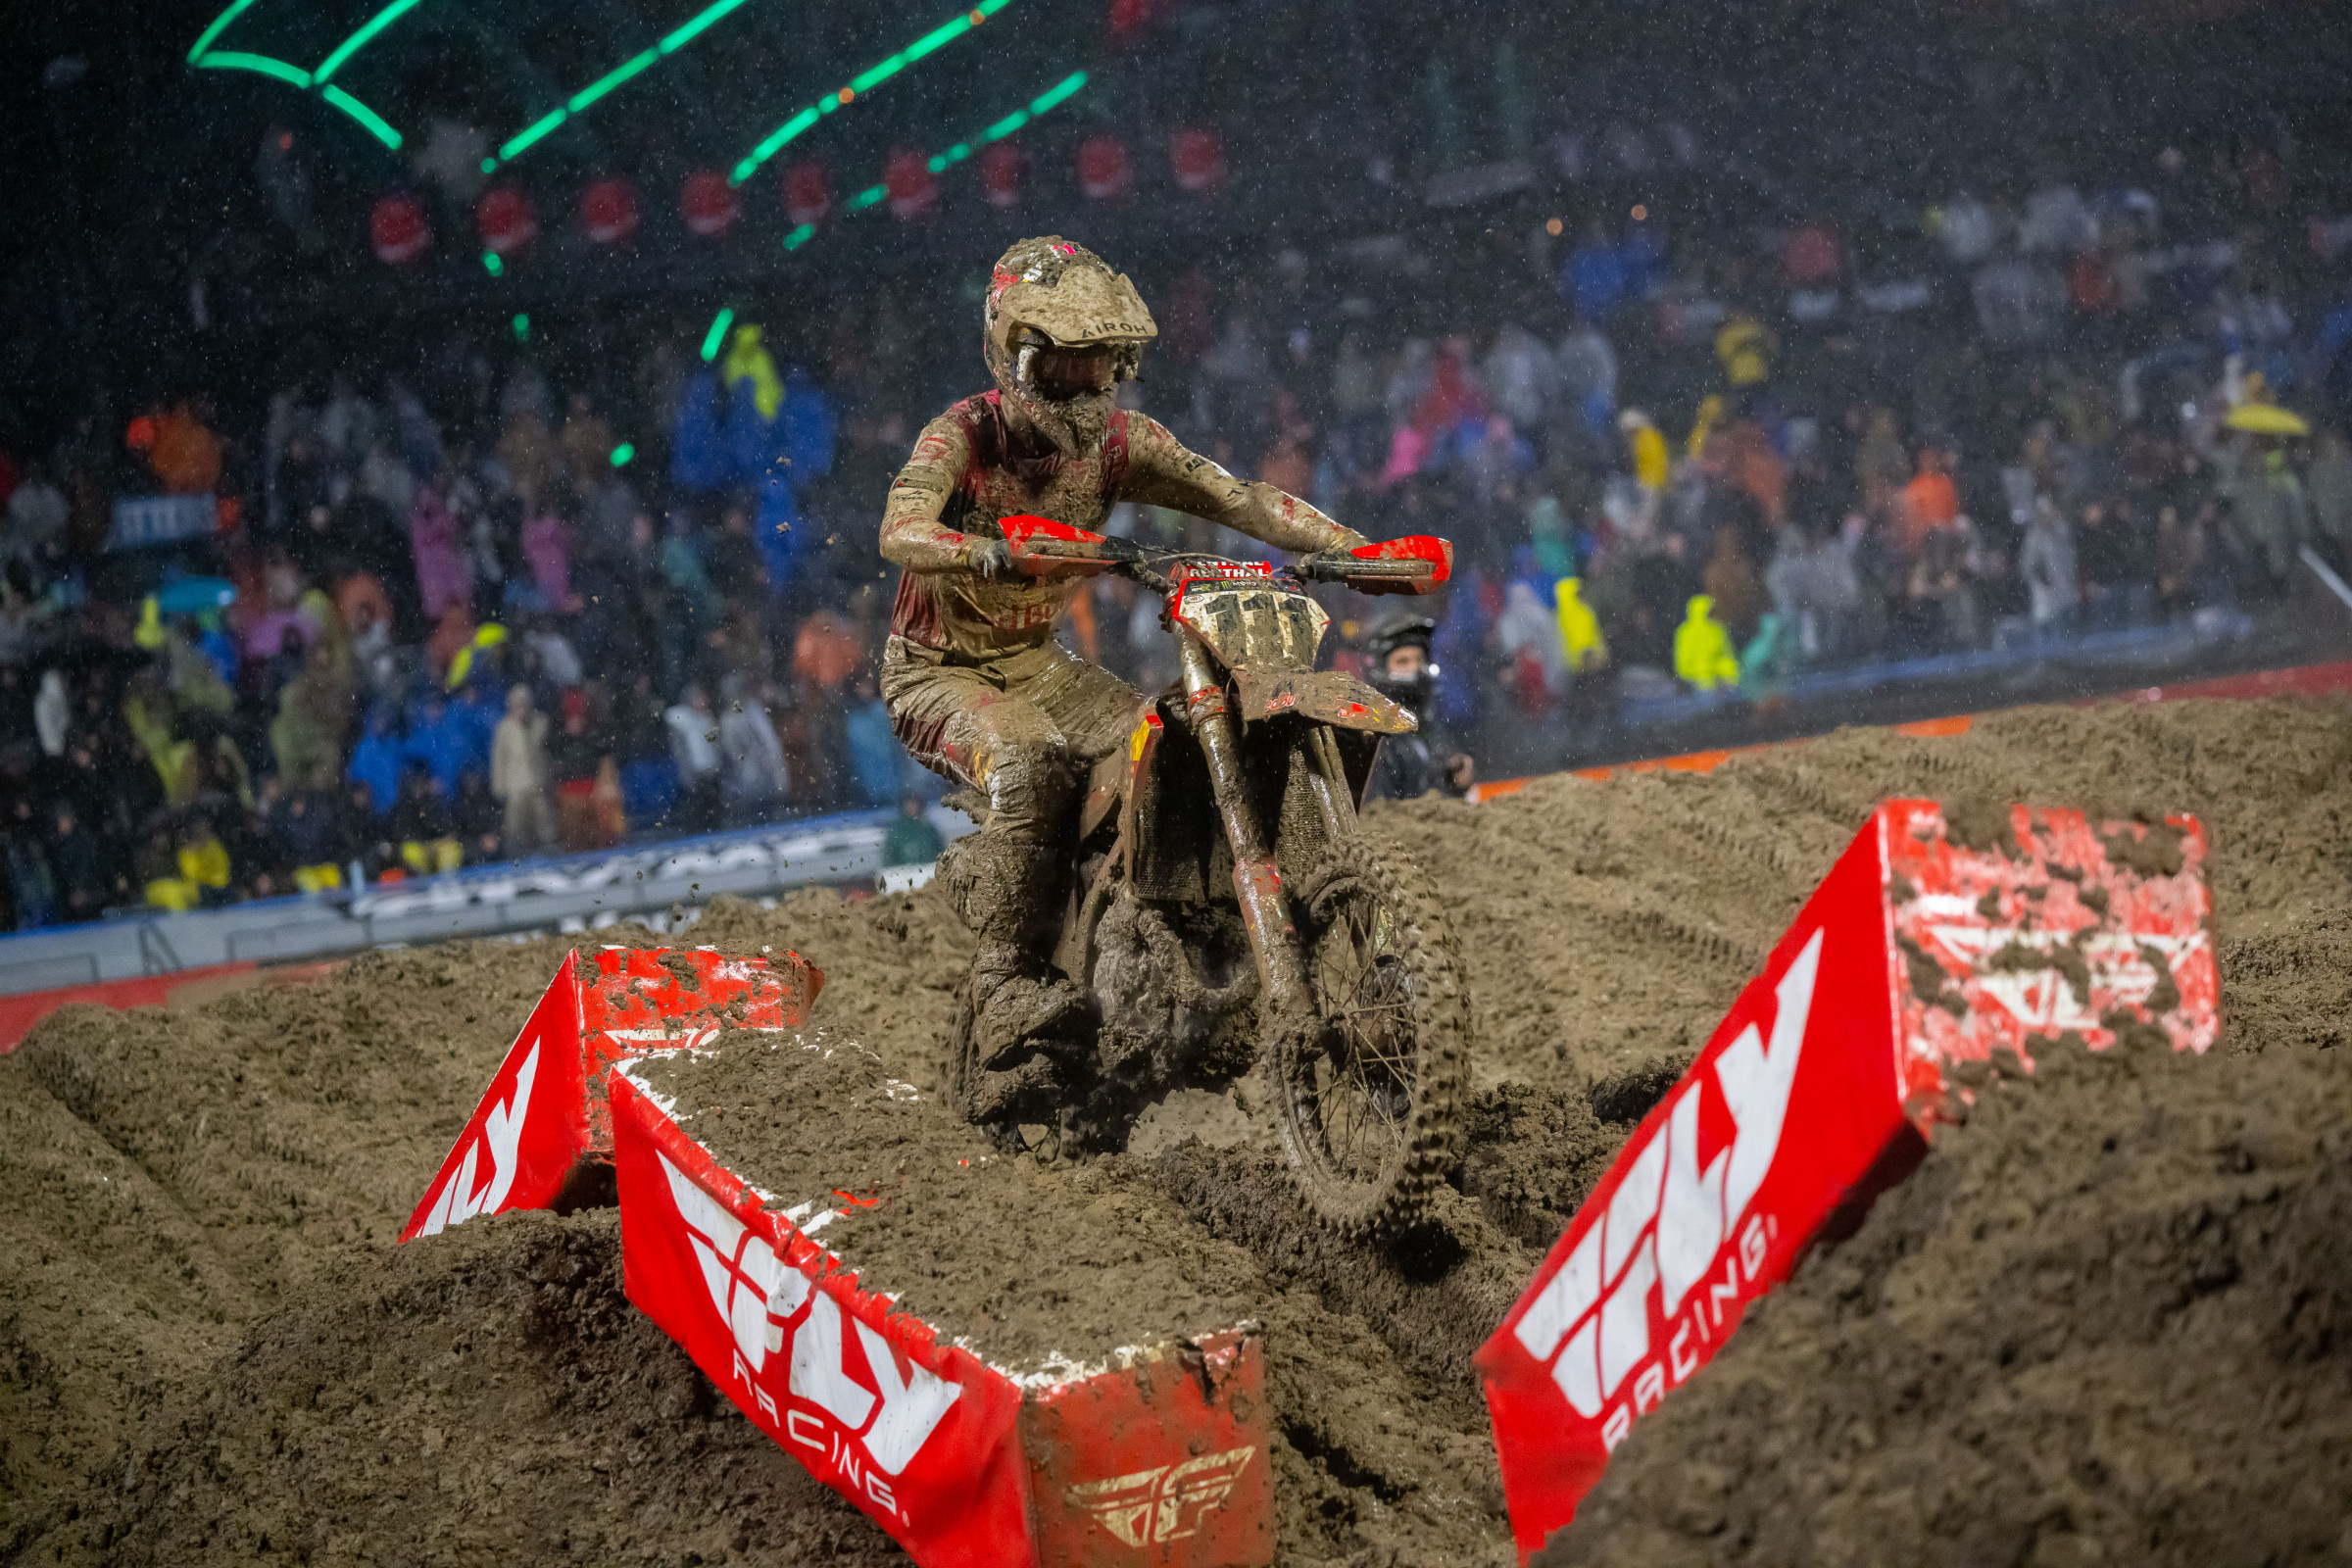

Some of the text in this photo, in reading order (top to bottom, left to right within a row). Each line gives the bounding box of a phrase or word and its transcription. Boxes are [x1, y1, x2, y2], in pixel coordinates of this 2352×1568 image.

[1082, 322, 1149, 339] AIROH
[655, 1149, 963, 1476] FLY
[1513, 927, 1825, 1418] FLY
[1599, 1214, 1778, 1452] RACING
